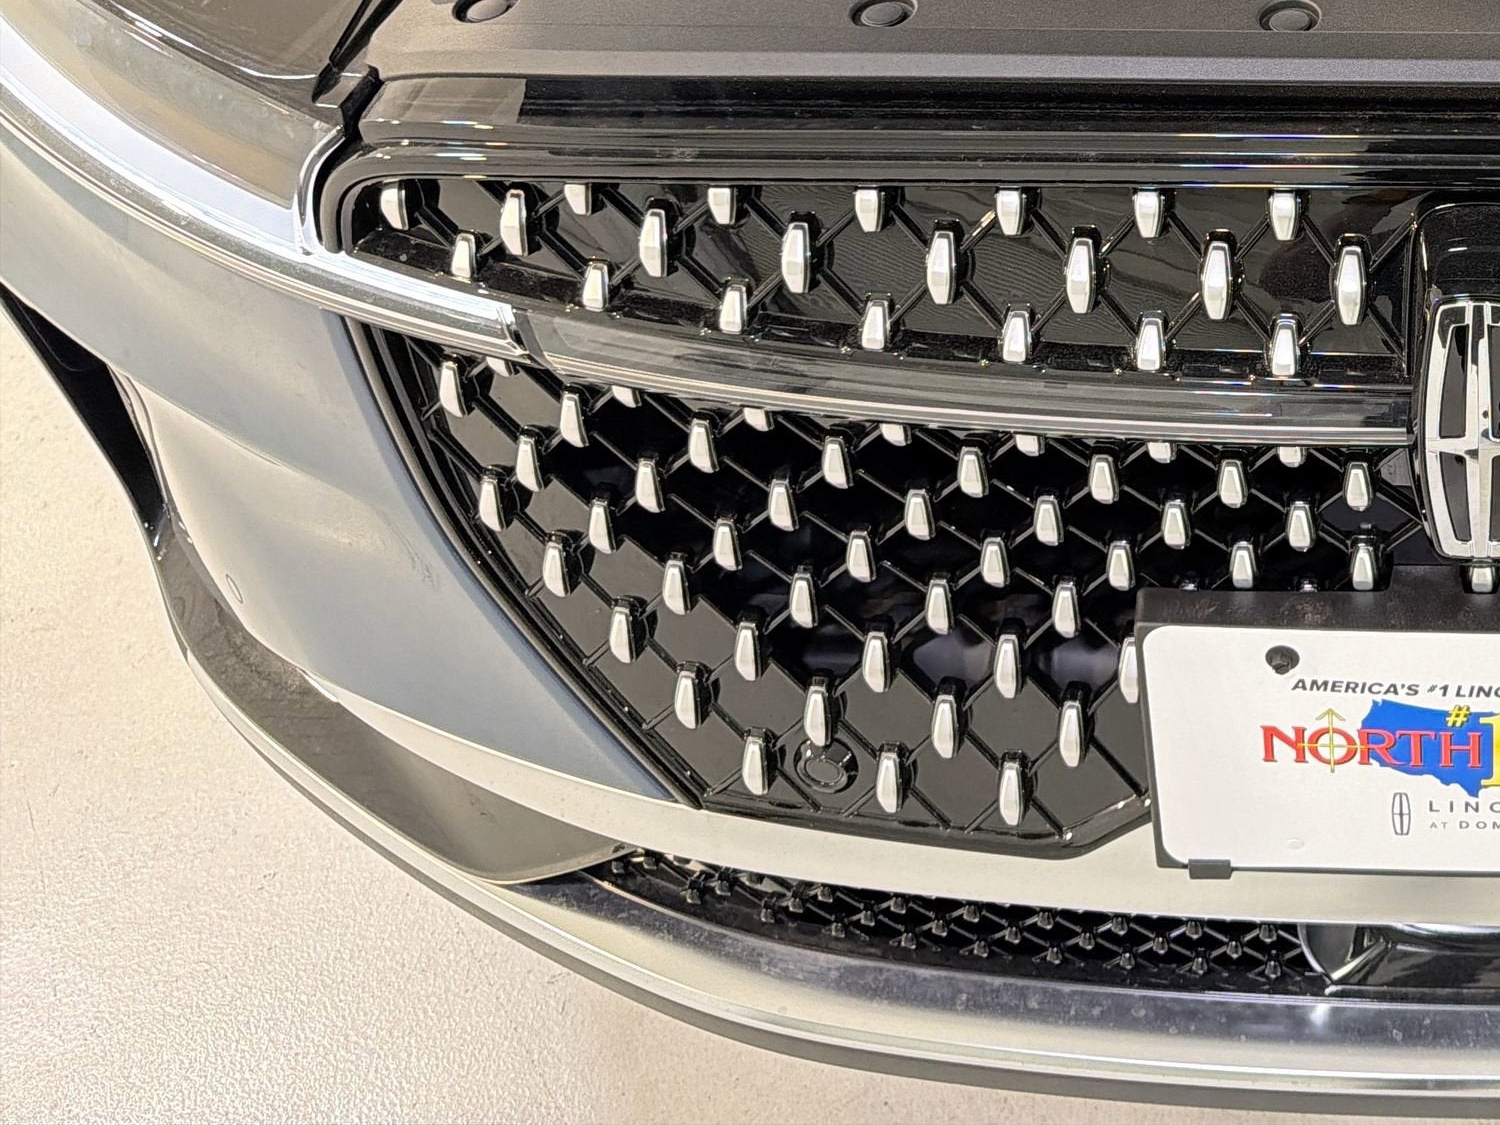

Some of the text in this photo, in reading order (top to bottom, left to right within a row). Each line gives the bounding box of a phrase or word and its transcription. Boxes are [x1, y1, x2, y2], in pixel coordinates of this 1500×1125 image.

[1291, 678, 1420, 696] AMERICA'S
[1427, 683, 1449, 698] #1
[1260, 724, 1483, 769] NORTH
[1429, 821, 1449, 830] AT
